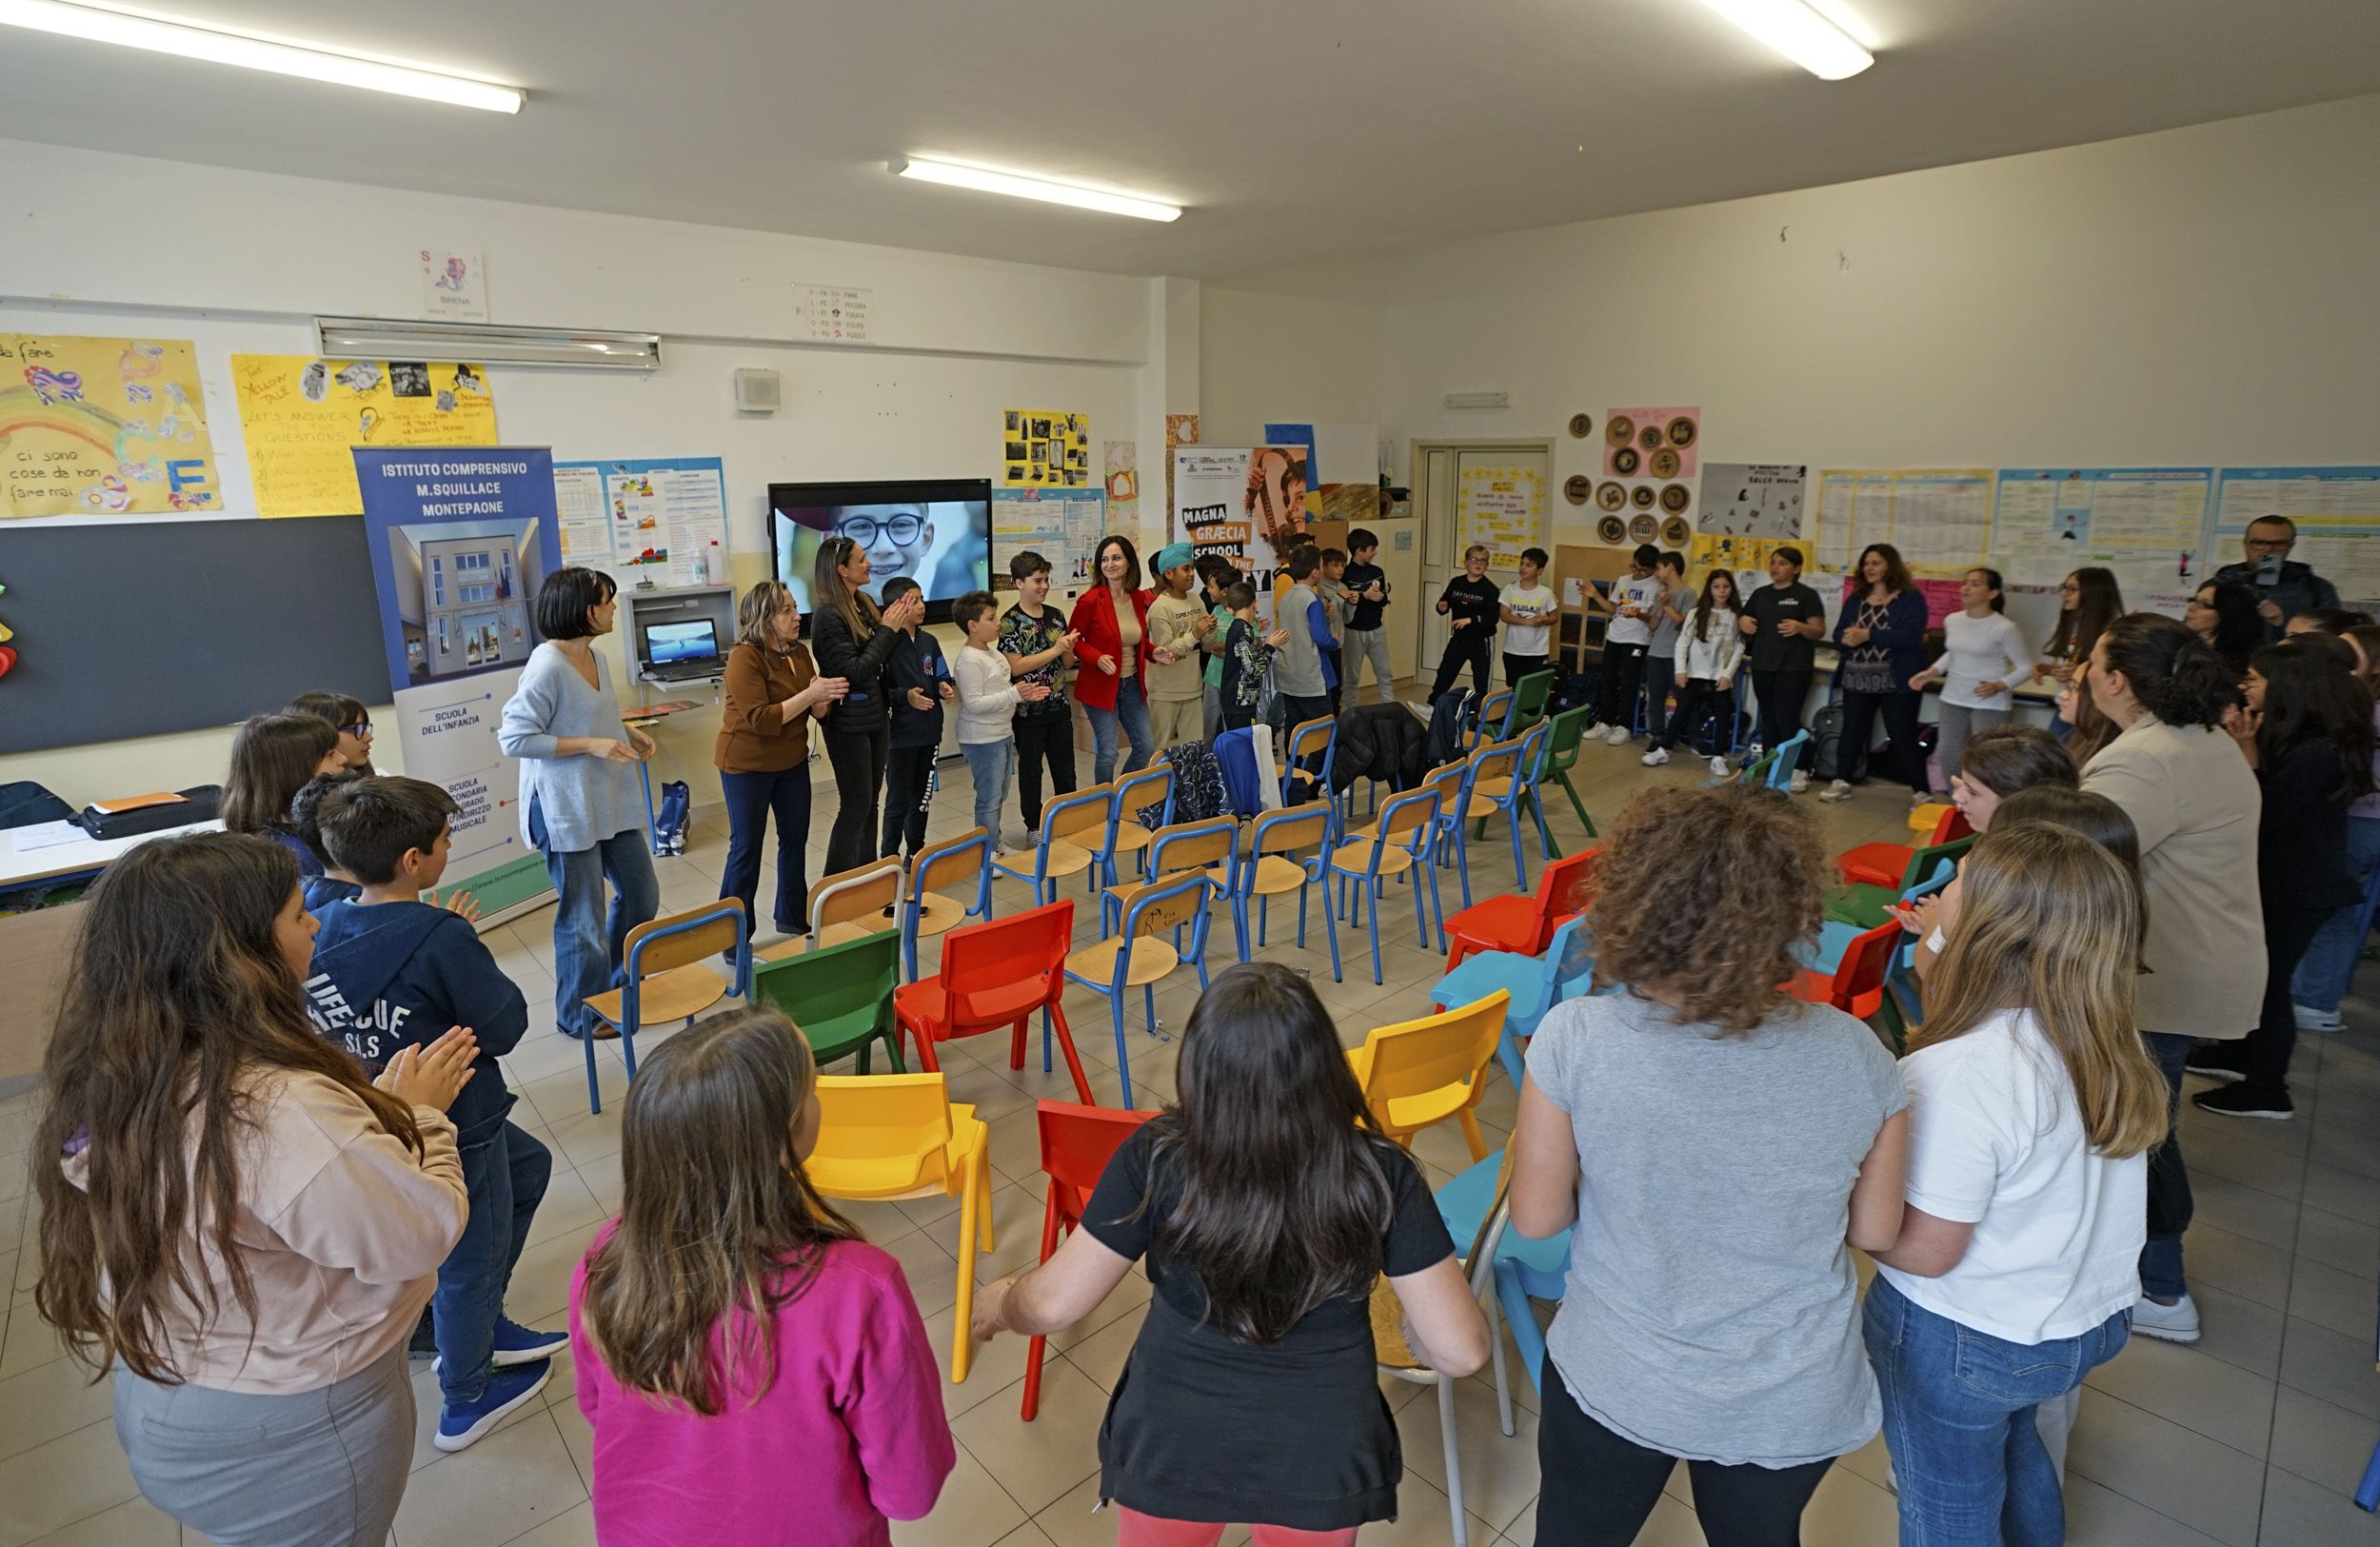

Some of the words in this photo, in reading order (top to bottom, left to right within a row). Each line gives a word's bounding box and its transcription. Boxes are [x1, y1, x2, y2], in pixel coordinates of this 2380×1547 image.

[19, 341, 54, 364] fare
[242, 372, 288, 401] YELLOW
[248, 411, 283, 423] LET'S
[290, 411, 352, 422] ANSWER
[264, 431, 347, 444] QUESTIONS
[16, 449, 33, 462] ci
[43, 450, 79, 462] sono
[10, 467, 47, 479] cose
[53, 466, 69, 479] da
[76, 468, 101, 478] non
[382, 464, 441, 478] ISTITUTO
[443, 462, 527, 475] COMPRENSIVO
[10, 484, 45, 504] fare
[416, 482, 502, 497] M.SQUILLACE
[422, 501, 504, 517] MONTEPAONE
[1183, 507, 1226, 523] MAGNA
[1196, 525, 1246, 540] GRÆCIA
[1235, 558, 1252, 570] THE
[435, 707, 467, 722] SCUOLA
[422, 715, 480, 736] DELL'INFANZIA
[448, 778, 478, 793] SCUOLA
[461, 796, 485, 809] GRADO
[450, 815, 486, 834] MUSICALE
